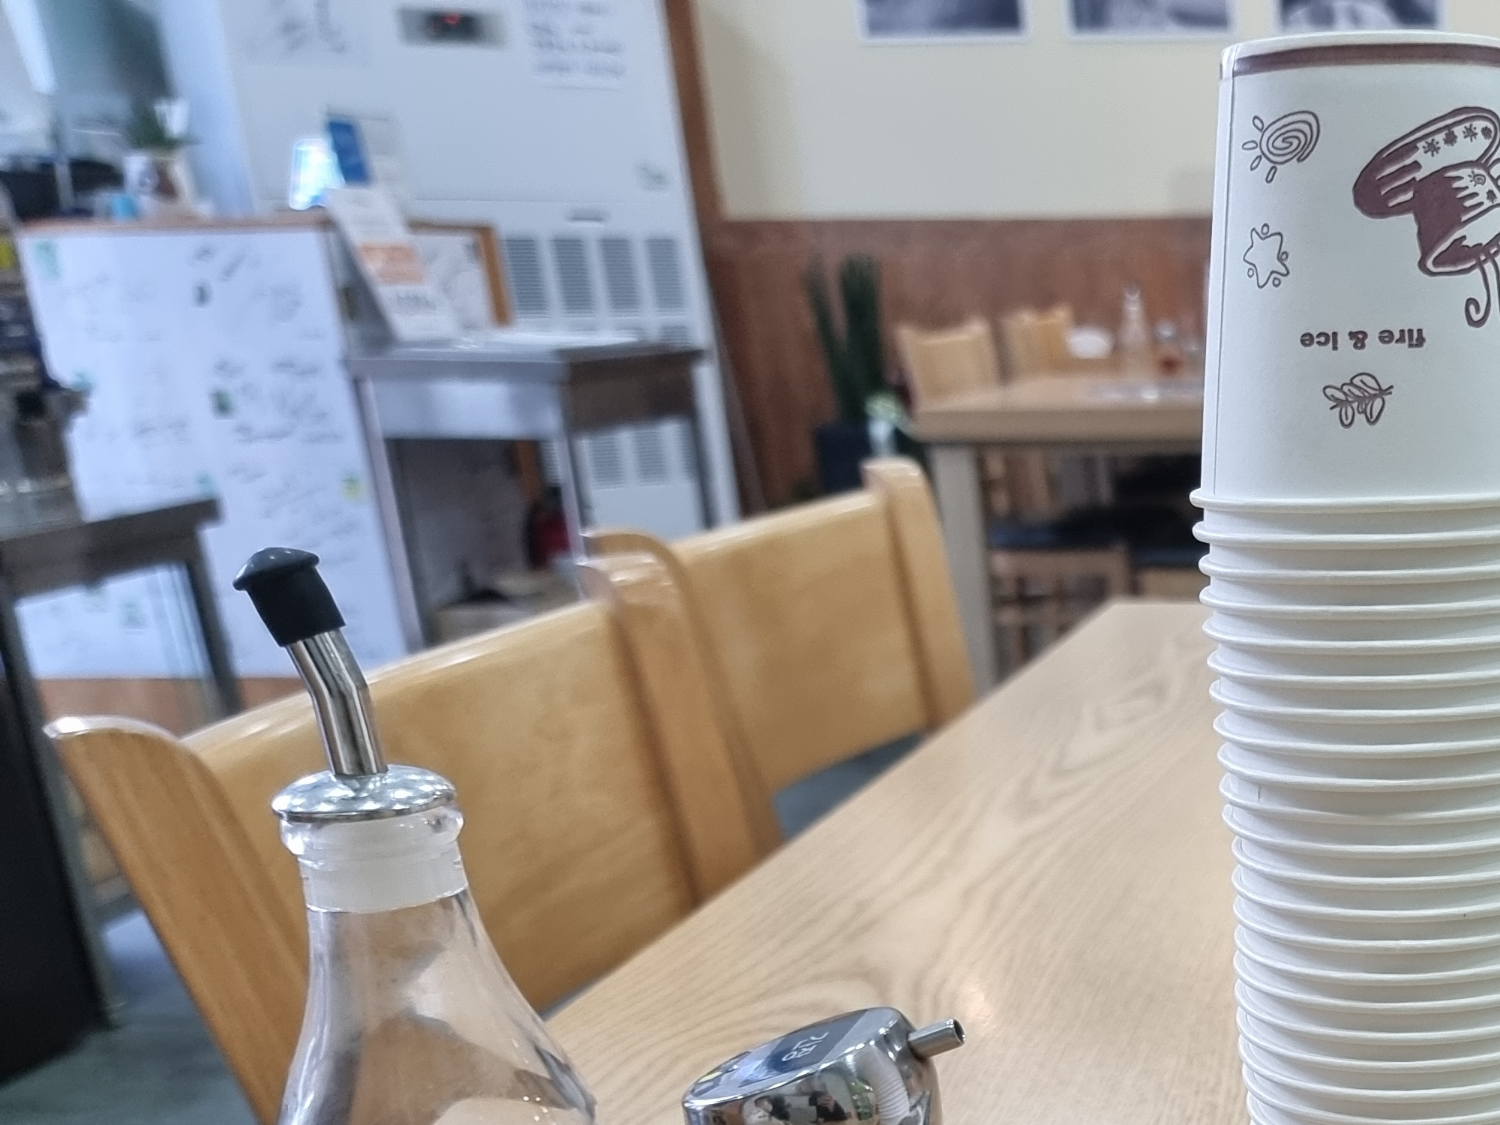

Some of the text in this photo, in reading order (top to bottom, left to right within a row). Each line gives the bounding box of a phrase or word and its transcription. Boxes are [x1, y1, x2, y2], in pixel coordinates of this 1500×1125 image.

[1299, 328, 1426, 351] fire & ice
[781, 1031, 830, 1062] 간장
